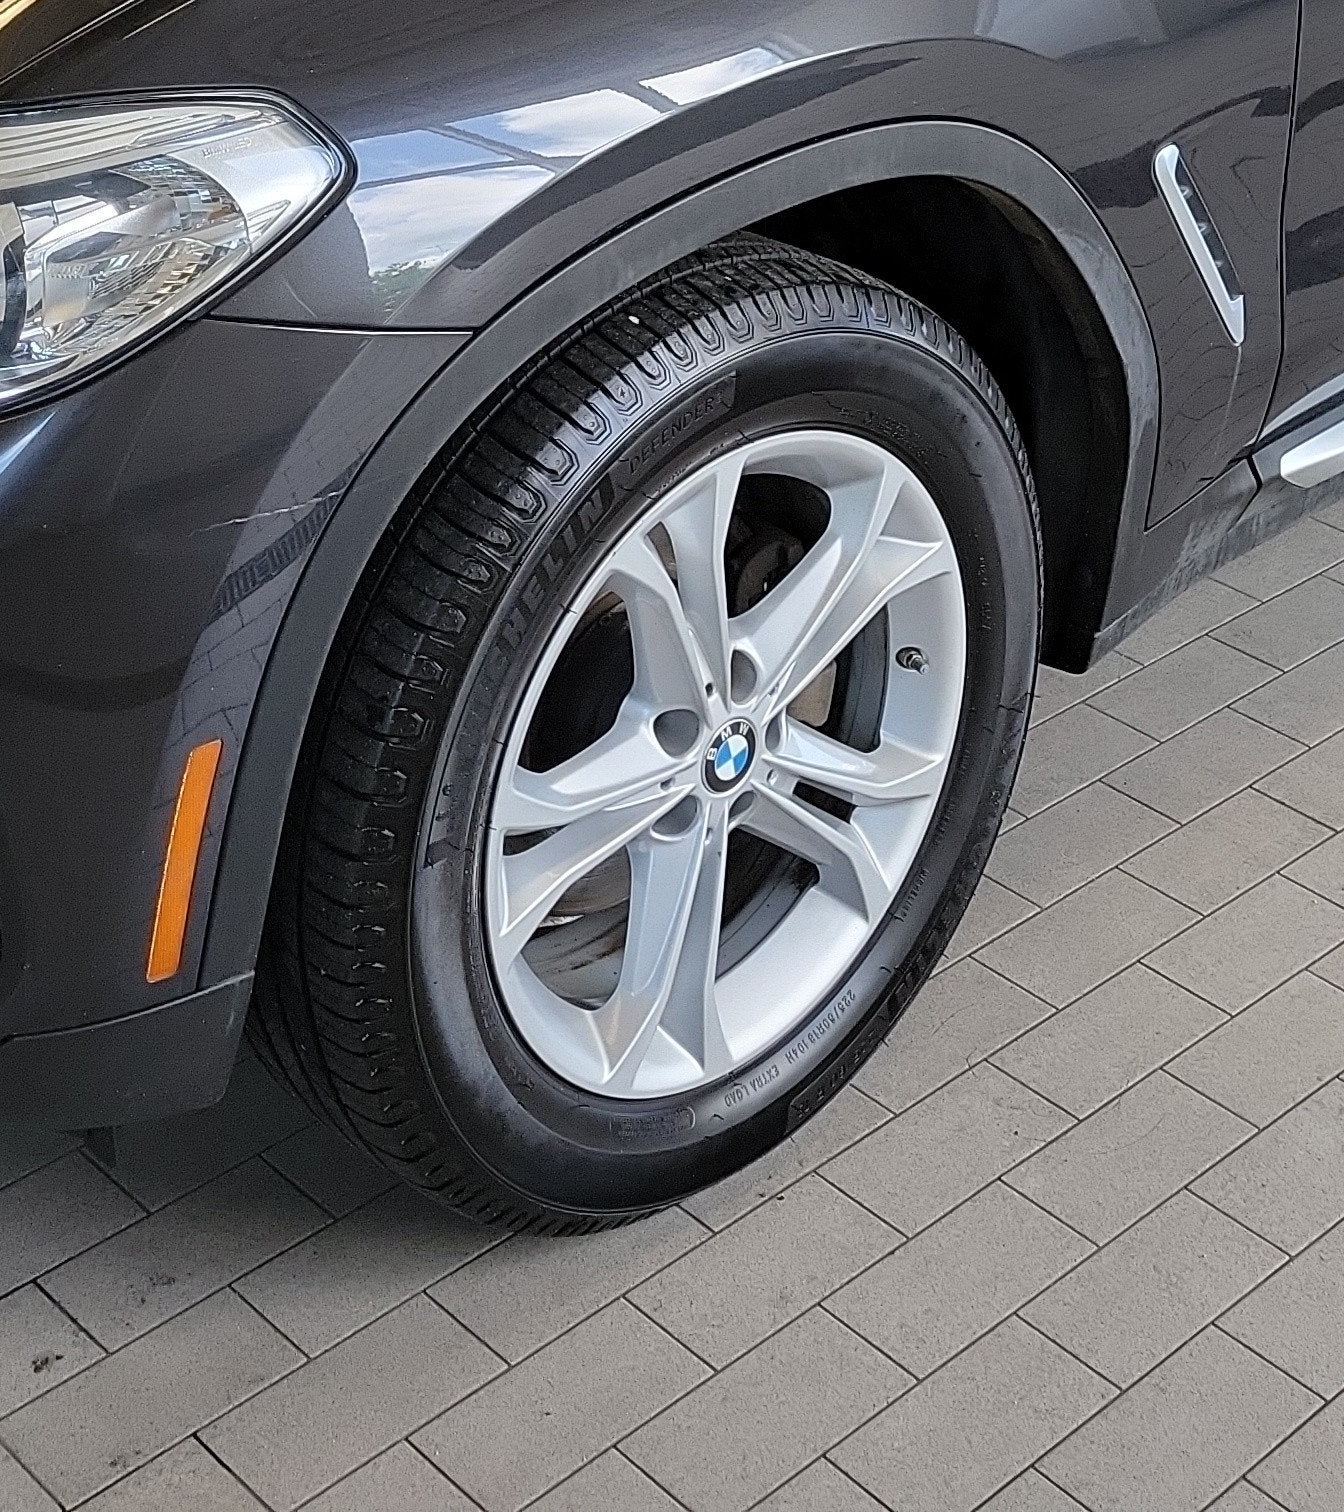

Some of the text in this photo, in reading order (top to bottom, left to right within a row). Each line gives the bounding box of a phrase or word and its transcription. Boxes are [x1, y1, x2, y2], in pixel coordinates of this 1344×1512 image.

[707, 722, 750, 761] BMW
[750, 1063, 780, 1093] EXTRA
[723, 1081, 750, 1108] LOAD
